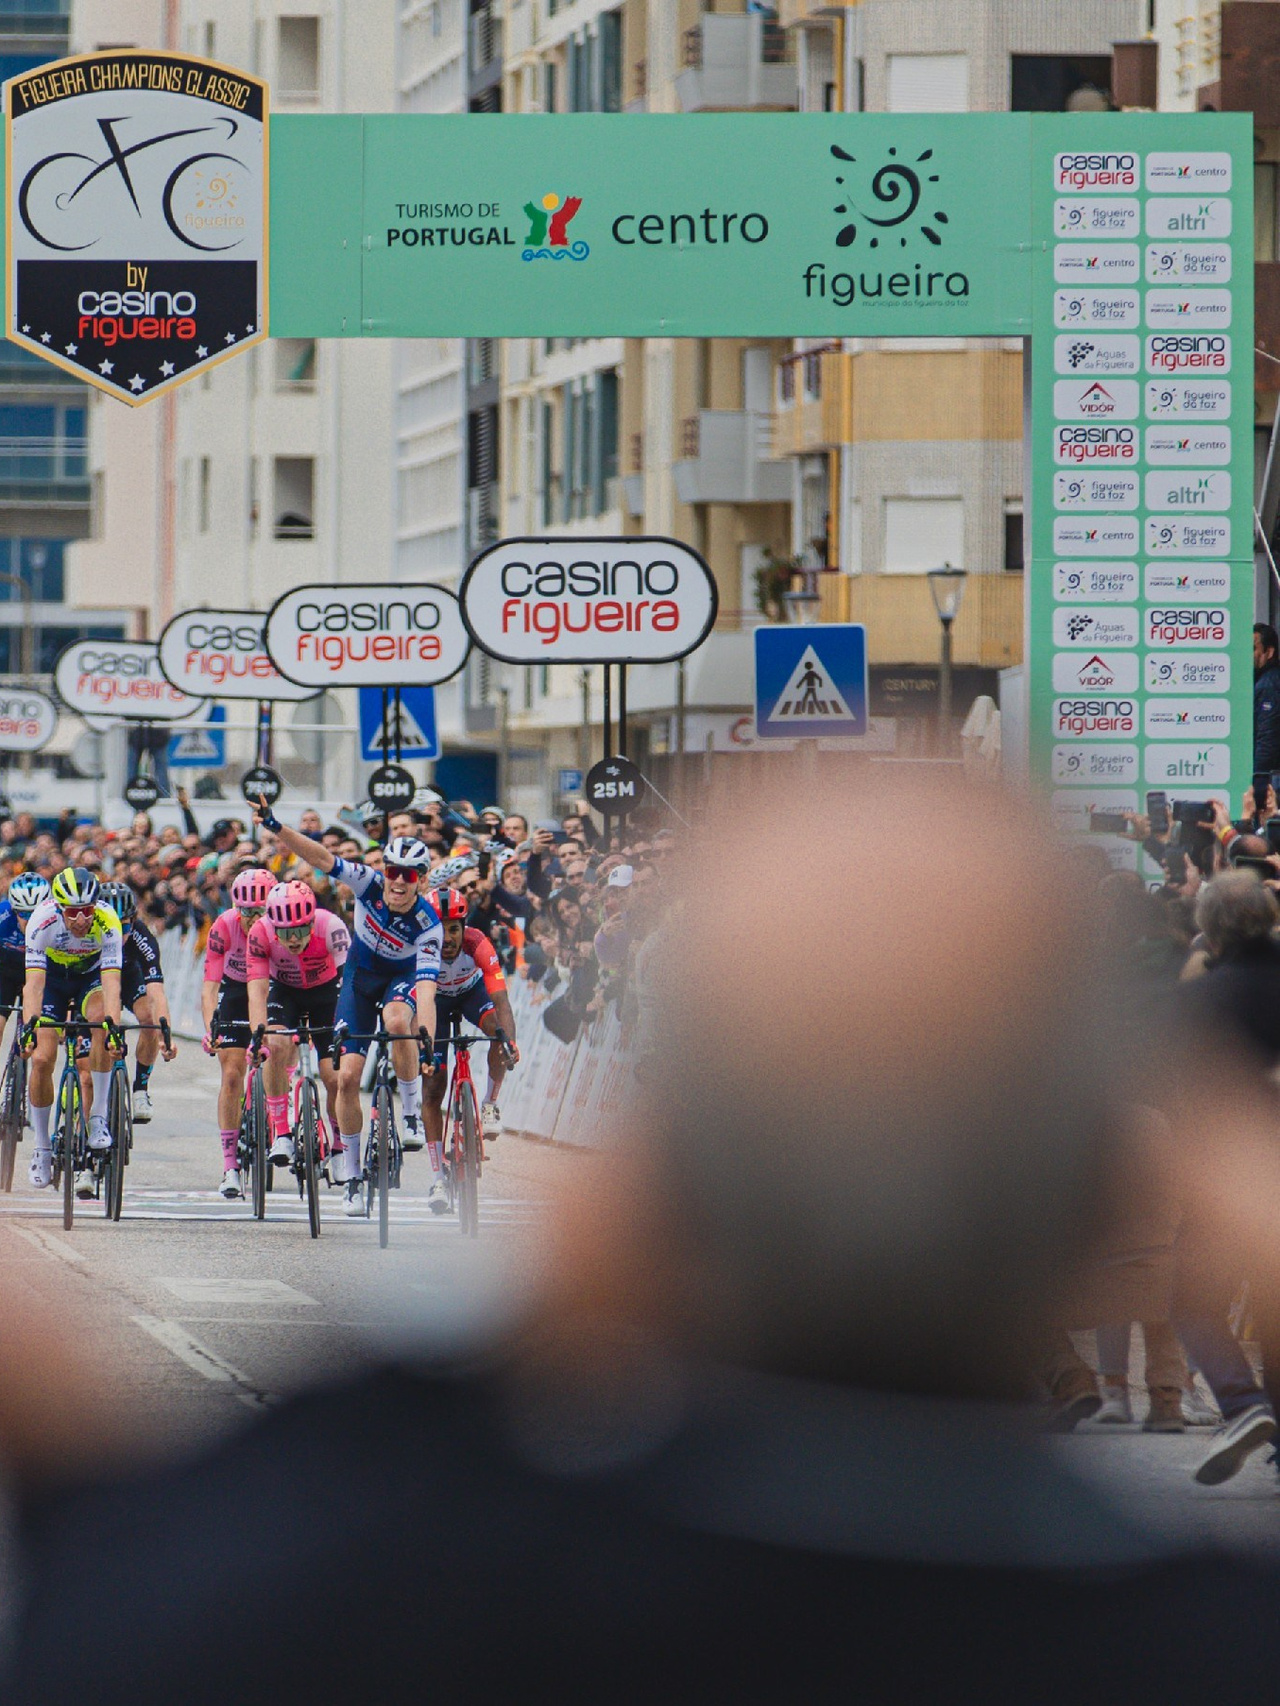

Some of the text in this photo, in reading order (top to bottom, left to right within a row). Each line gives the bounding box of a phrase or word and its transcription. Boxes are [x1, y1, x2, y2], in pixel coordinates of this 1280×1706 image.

[19, 64, 250, 109] FIGUEIRA CHAMPIONS CLASSIC
[1060, 156, 1134, 170] casino
[1195, 168, 1227, 176] centro
[1061, 170, 1134, 189] figueira
[396, 203, 500, 218] TURISMO DE
[1093, 208, 1134, 218] figueira
[185, 213, 245, 229] figueira
[612, 207, 769, 244] centro
[1109, 218, 1125, 226] foz
[1168, 213, 1205, 230] altri
[387, 227, 516, 246] PORTUGAL
[1104, 259, 1134, 267] centro
[1184, 254, 1226, 263] figueira
[1200, 263, 1216, 272] foz
[127, 262, 148, 291] by
[803, 264, 969, 306] figueira
[78, 292, 196, 315] casino
[1093, 300, 1134, 309] figueira
[1109, 309, 1125, 317] foz
[78, 316, 196, 346] figueira
[1152, 337, 1225, 352] casino
[1096, 360, 1134, 369] Figueira
[1152, 352, 1225, 371] figueira
[1184, 390, 1225, 400] figueira
[1200, 400, 1216, 408] foz
[1060, 428, 1133, 442] casino
[1194, 441, 1226, 449] centro
[1060, 443, 1133, 462] figueira
[1092, 482, 1134, 491] figueira
[1108, 491, 1125, 499] foz
[1167, 487, 1205, 503] altri
[1102, 532, 1134, 540] centro
[1184, 527, 1225, 537] figueira
[1199, 536, 1216, 545] foz
[501, 561, 679, 597] casino
[1092, 572, 1134, 582] figueira
[1194, 578, 1225, 586] centro
[1108, 582, 1124, 590] foz
[297, 603, 441, 631] casino
[502, 599, 679, 644] figueira
[1151, 611, 1224, 625] casino
[1094, 633, 1132, 643] Figueira
[1151, 626, 1224, 644] figueira
[297, 634, 441, 671] figueira
[185, 650, 276, 684] figue
[1183, 663, 1224, 673] figueira
[1199, 672, 1215, 681] foz
[1059, 701, 1132, 716] casino
[1193, 714, 1225, 722] centro
[1059, 716, 1132, 735] figueira
[1091, 755, 1133, 764] figueira
[1108, 764, 1123, 772] foz
[1167, 760, 1204, 776] altri
[374, 783, 409, 797] 50M
[594, 780, 634, 798] 25M
